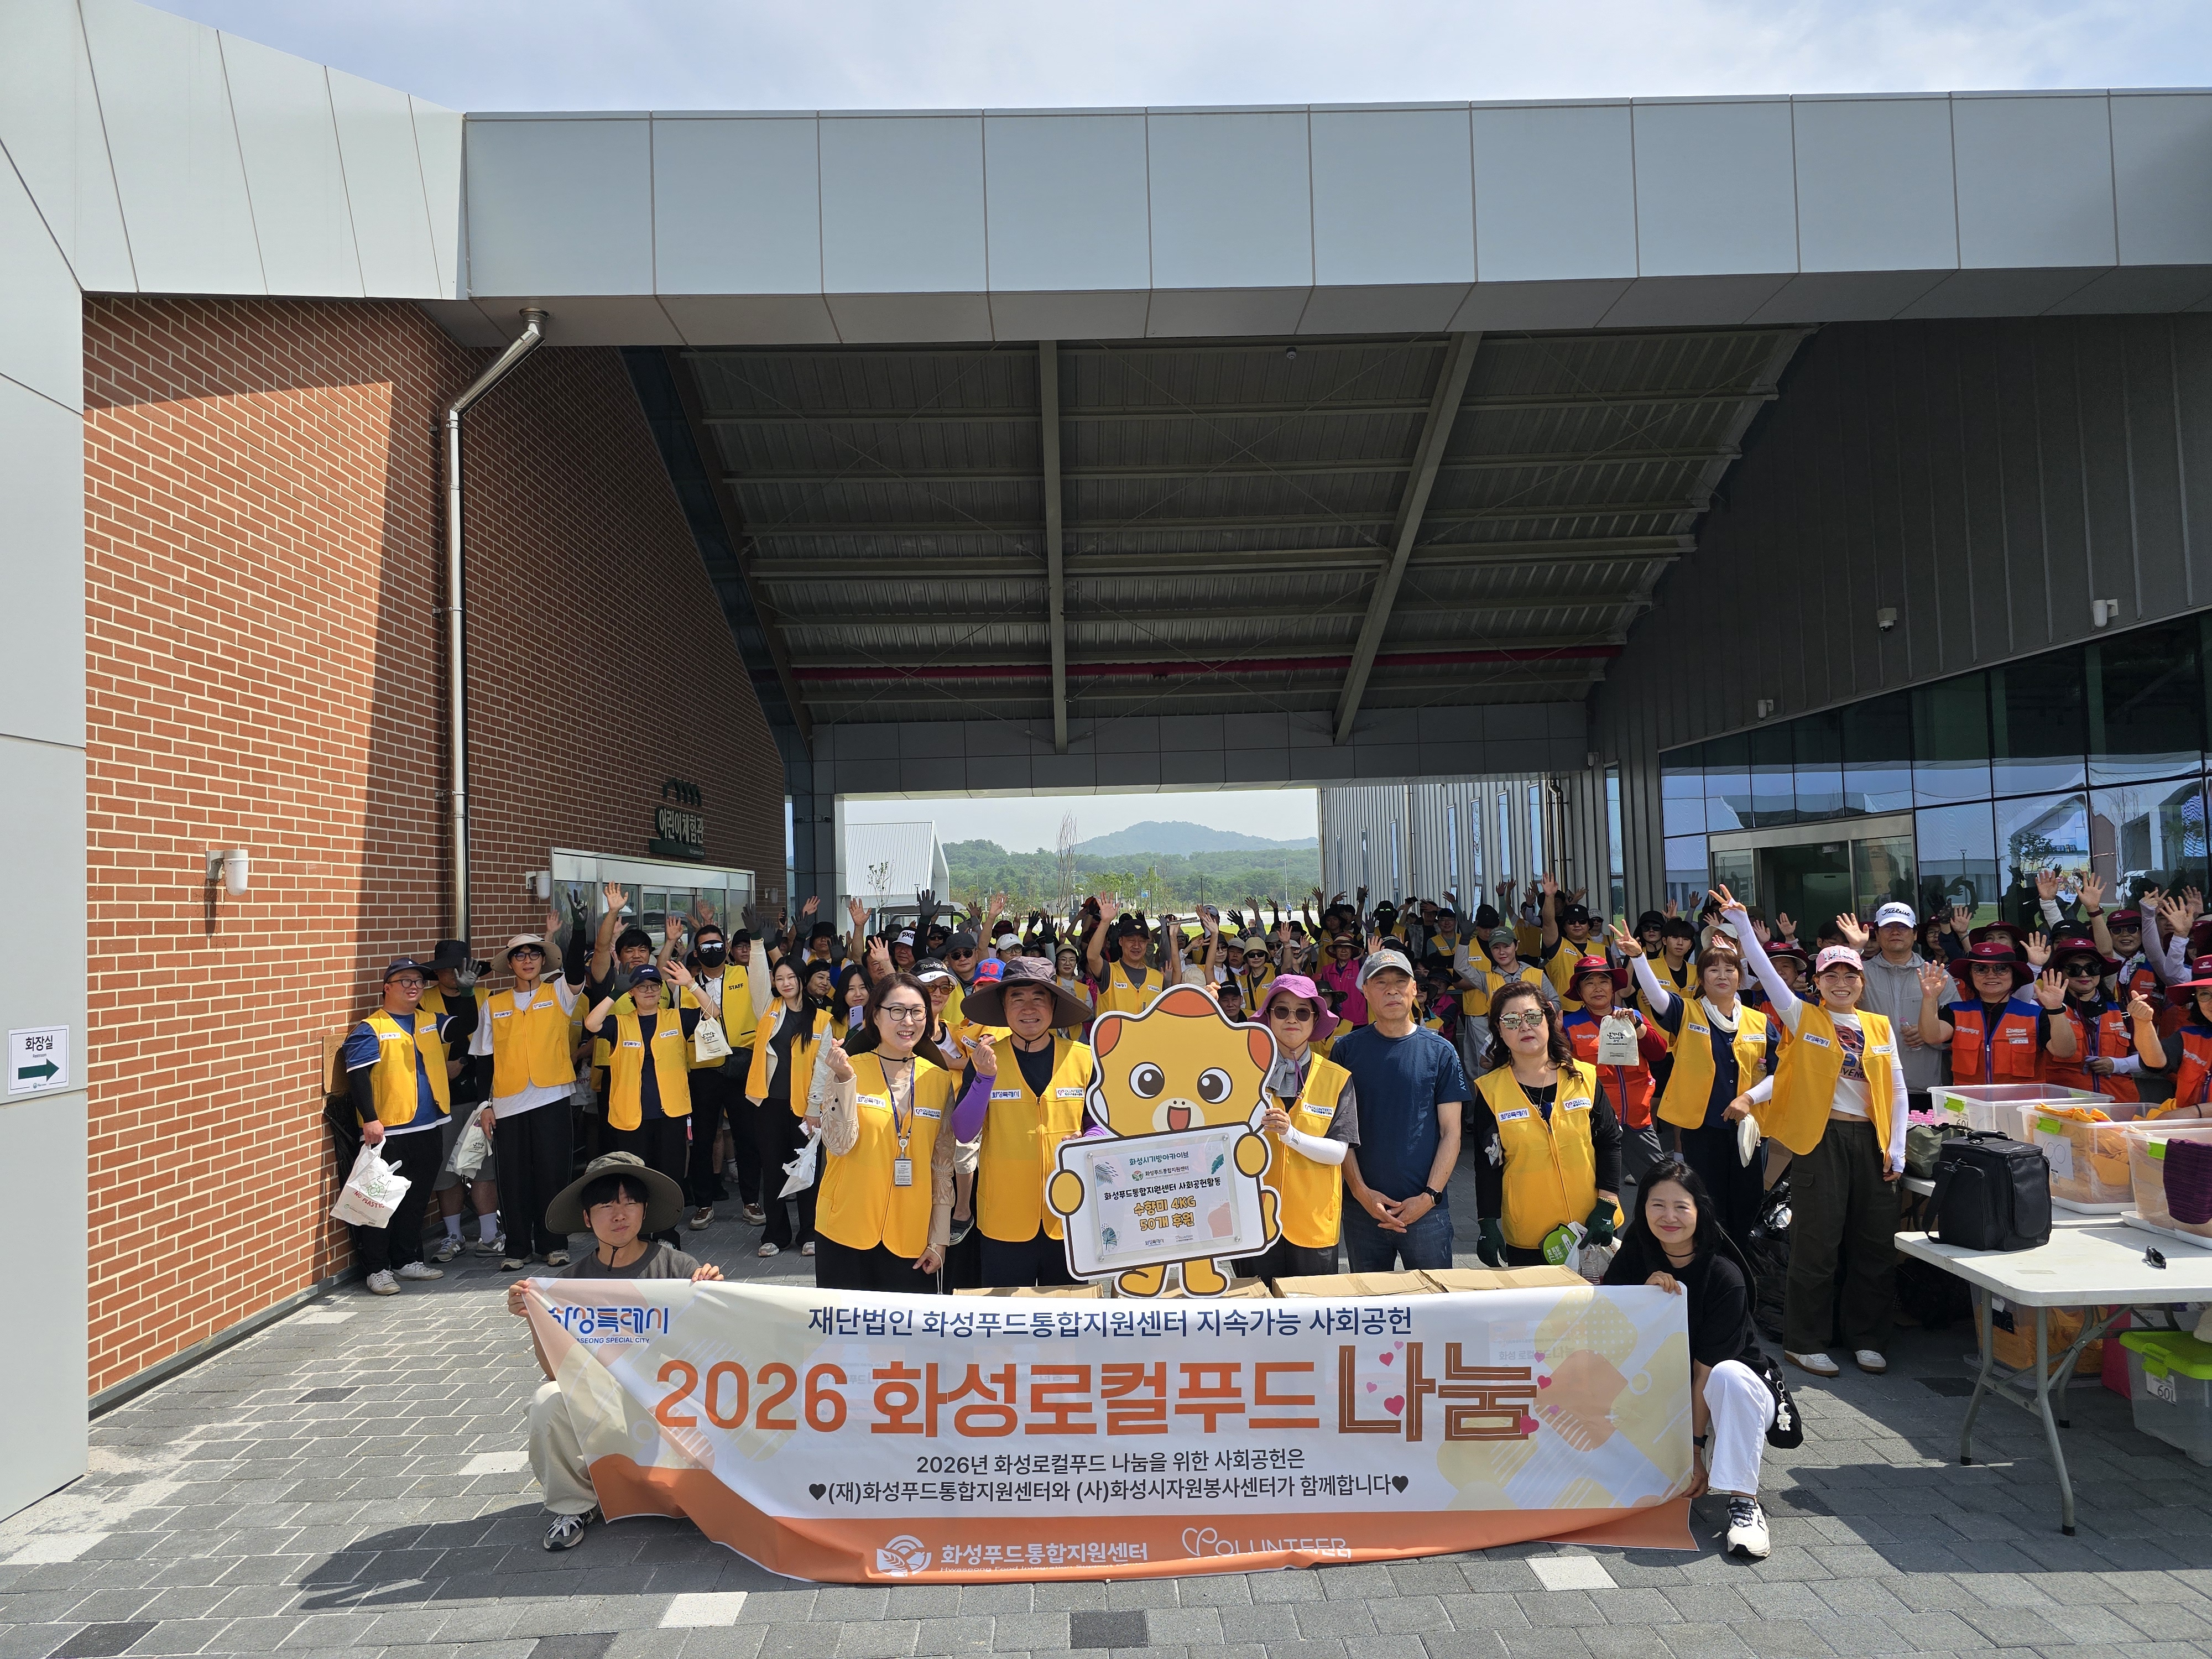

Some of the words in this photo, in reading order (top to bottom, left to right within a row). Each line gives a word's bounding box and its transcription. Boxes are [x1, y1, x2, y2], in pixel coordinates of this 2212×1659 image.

[659, 808, 704, 844] 어린이체험관
[1882, 907, 1911, 917] Titleist
[25, 1035, 53, 1051] 화장실
[857, 1096, 884, 1106] 화성특례시
[992, 1091, 1020, 1099] 화성특례시
[1129, 1151, 1189, 1166] 화성시기빙아카이브
[1145, 1166, 1189, 1176] 화성푸드통합지원센터
[1104, 1183, 1176, 1201] 화성푸드통합지원센터
[1179, 1177, 1221, 1190] 사회공헌활동
[354, 1191, 362, 1199] NO
[362, 1197, 385, 1209] PLASTIC
[1134, 1199, 1168, 1216] 수향미
[1171, 1196, 1196, 1209] 4KG
[1140, 1215, 1170, 1232] 50개
[1172, 1212, 1195, 1228] 후원
[808, 1307, 913, 1335] 재단법인
[922, 1311, 1187, 1338] 화성푸드통합지원센터
[1197, 1308, 1301, 1337] 지속가능
[1310, 1307, 1411, 1335] 사회공헌
[656, 1360, 848, 1433] 2026
[871, 1361, 1320, 1438] 화성로컬푸드
[1338, 1342, 1537, 1442] 나눔
[2157, 1385, 2177, 1404] 60L
[917, 1454, 988, 1475] 2026년
[994, 1454, 1107, 1475] 화성로컬푸드
[1113, 1452, 1167, 1473] 나눔을
[1172, 1450, 1209, 1472] 위한
[1214, 1448, 1305, 1471] 사회공헌은
[828, 1481, 1071, 1505] (재)화성푸드통합지원센터와
[1077, 1475, 1295, 1503] (사)화성시자원봉사센터가
[1300, 1474, 1391, 1496] 함께합니다
[941, 1543, 1147, 1565] 화성푸드통합지원센터
